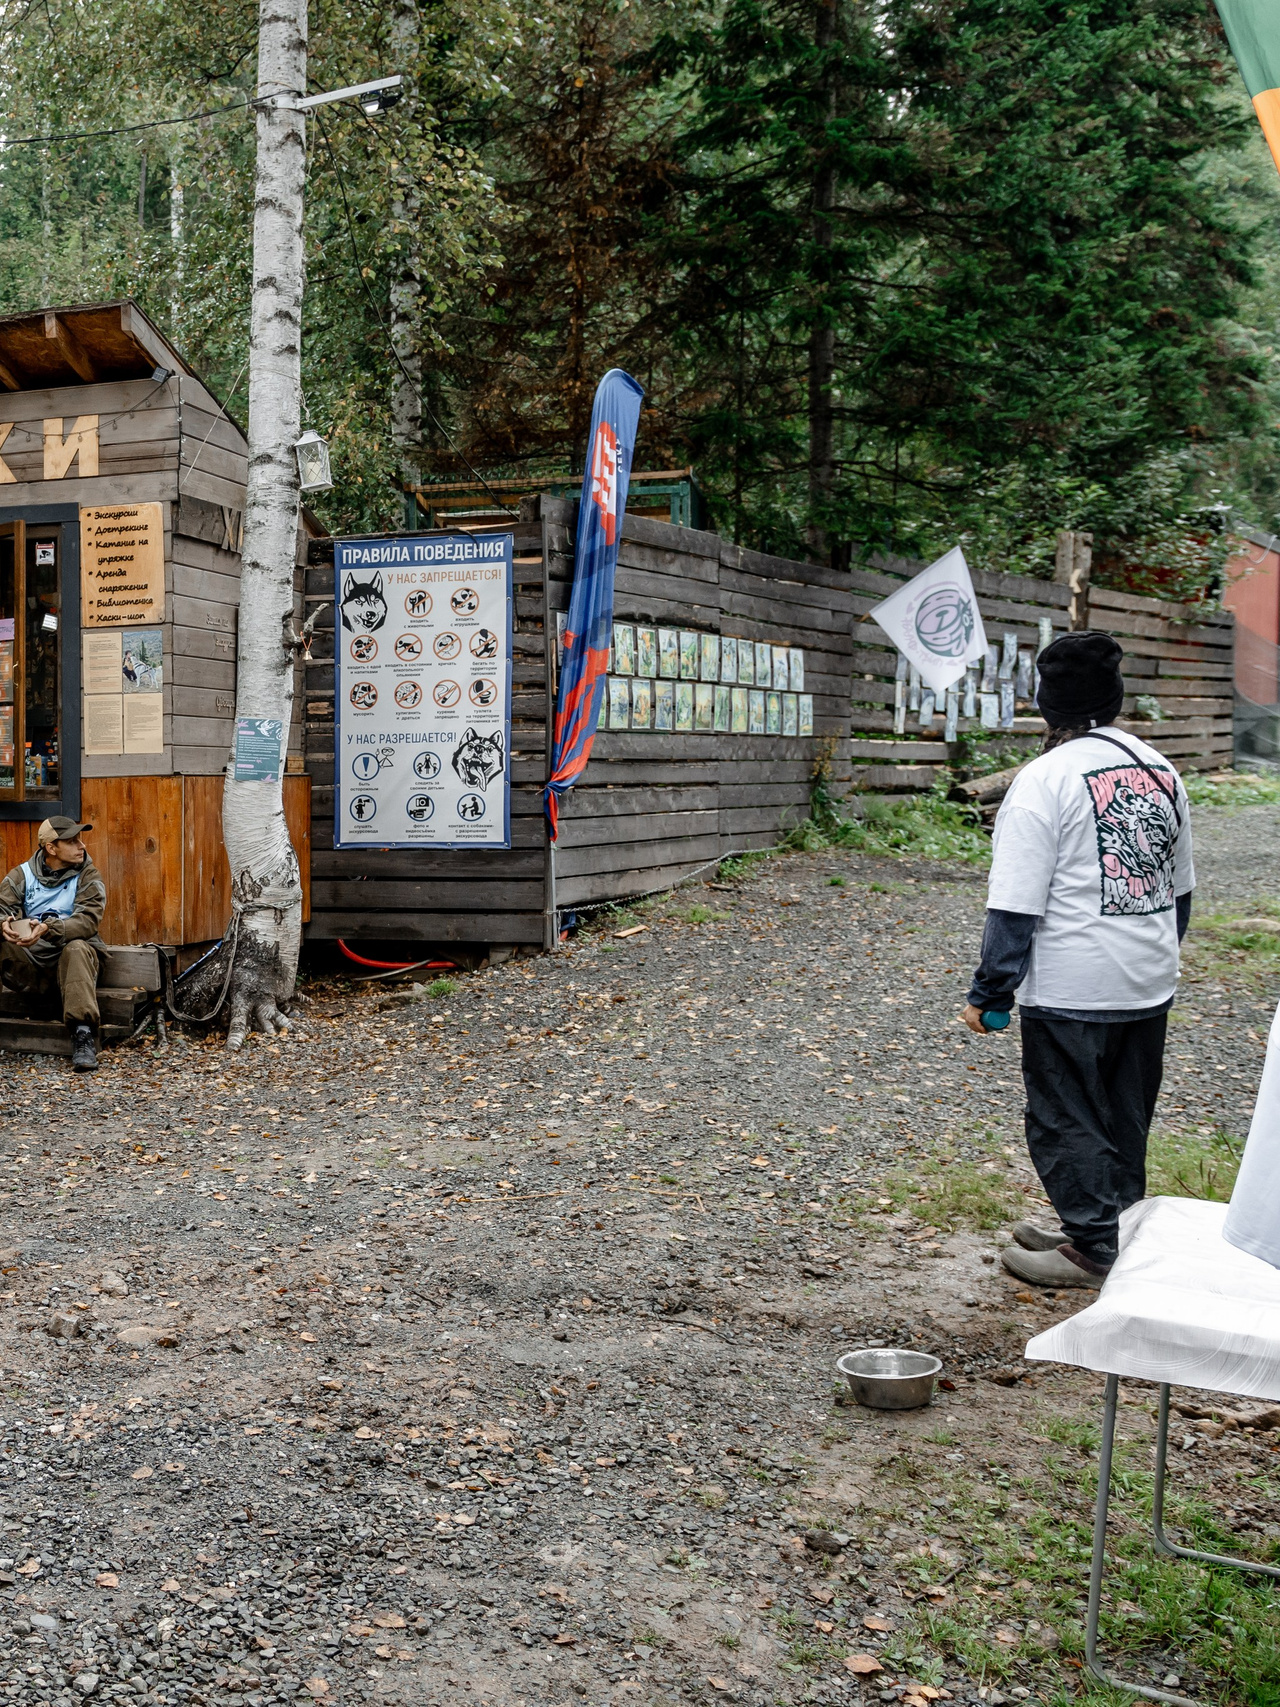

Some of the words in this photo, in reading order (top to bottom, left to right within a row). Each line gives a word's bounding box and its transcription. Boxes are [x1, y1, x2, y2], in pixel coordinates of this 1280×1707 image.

[94, 509, 138, 520] Экскурсии
[96, 540, 136, 549] Катание
[342, 545, 411, 564] ПРАВИЛА
[414, 541, 505, 562] ПОВЕДЕНИЯ
[97, 554, 135, 565] упряжке
[96, 568, 127, 580] Аренда
[387, 574, 395, 584] У
[396, 572, 417, 584] НАС
[419, 569, 502, 583] ЗАПРЕЩАЕТСЯ!
[98, 582, 149, 594] снаряжения
[96, 613, 146, 622] Хаски-шоп
[347, 734, 353, 745] У
[356, 734, 376, 744] НАС
[379, 732, 457, 744] РАЗРЕШАЕТСЯ!
[1087, 767, 1175, 817] ДОГТРЕК
